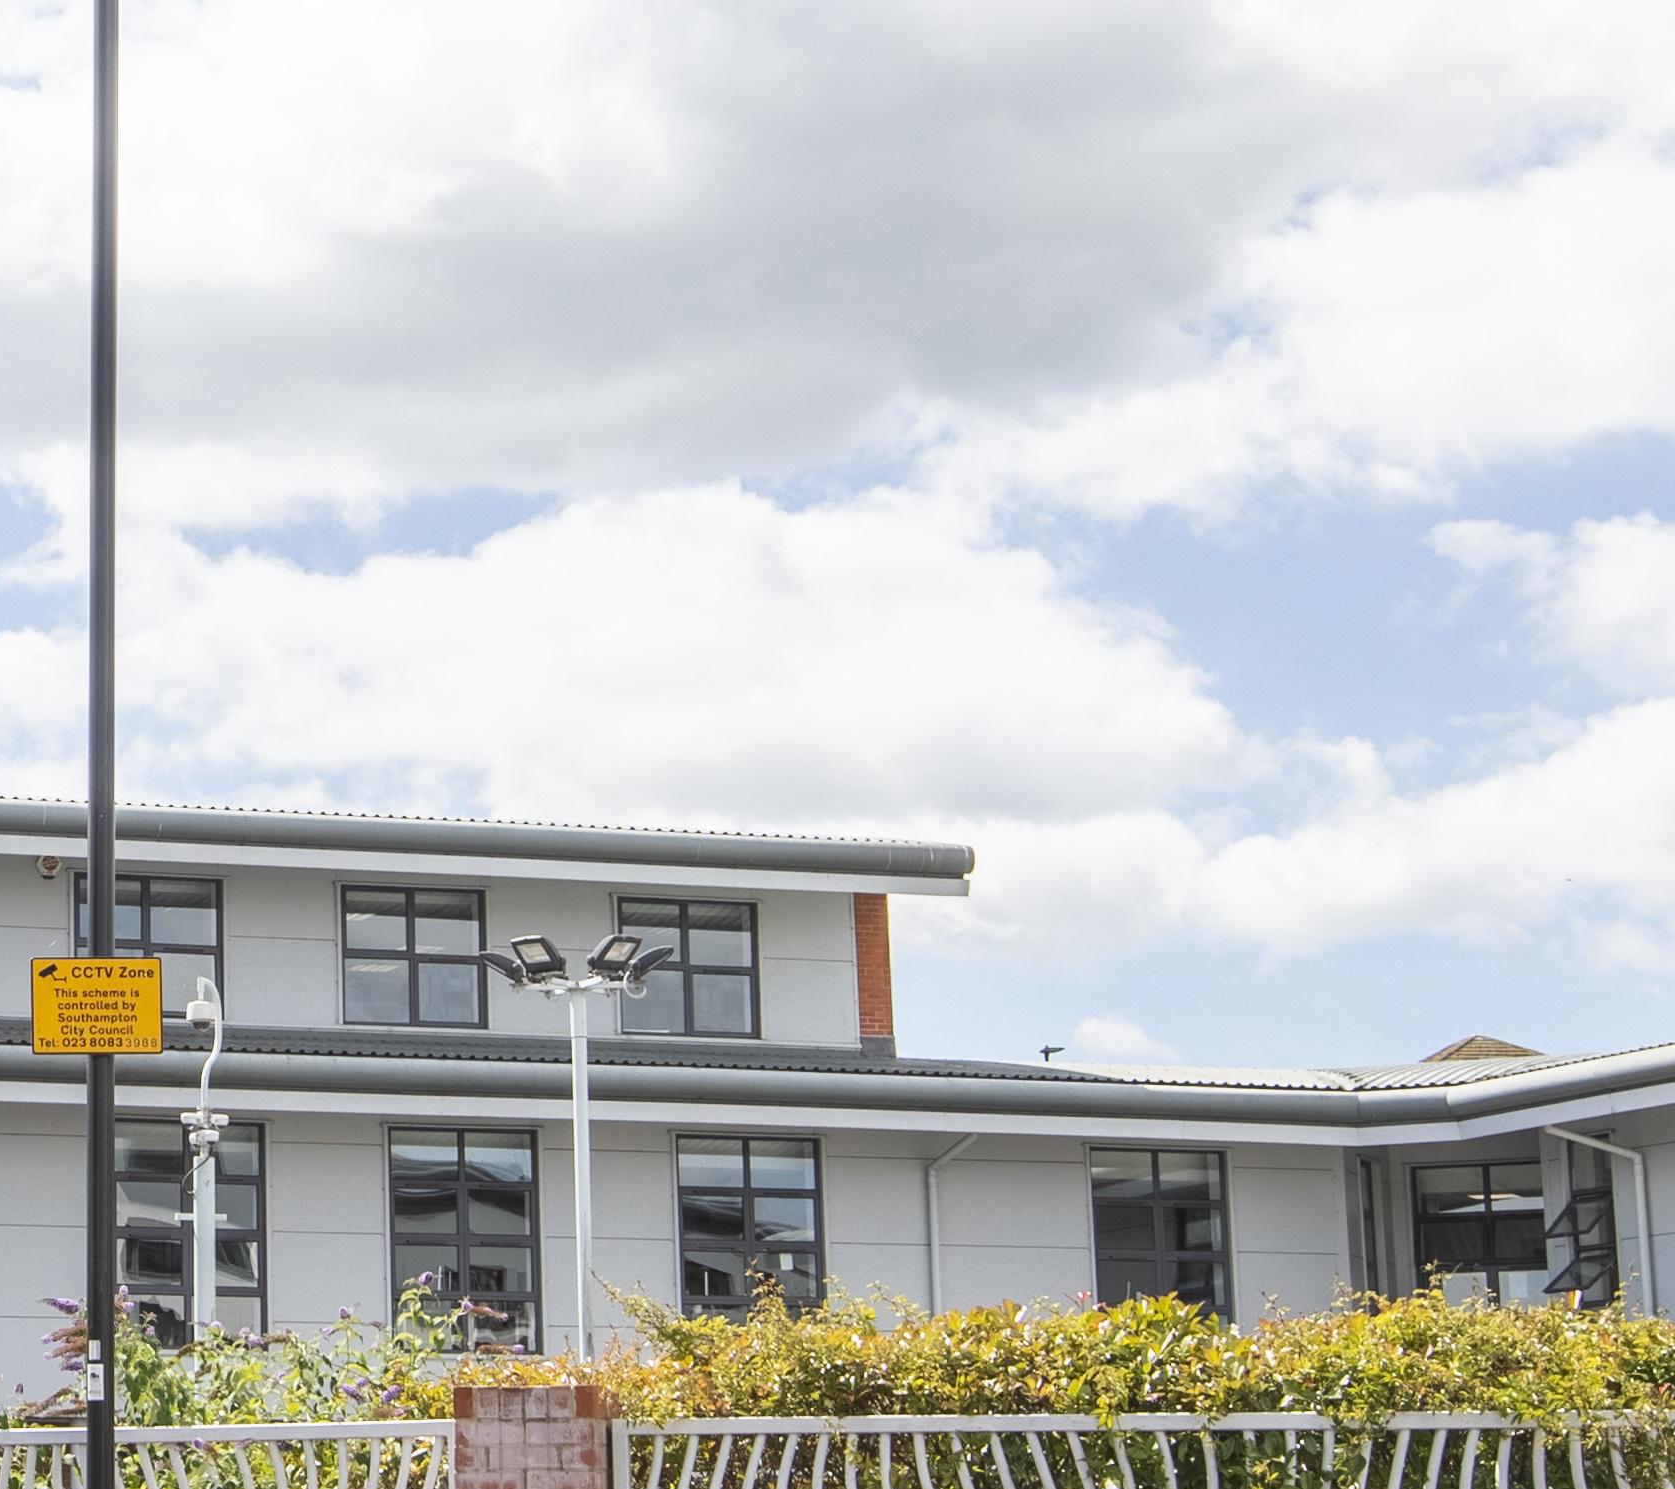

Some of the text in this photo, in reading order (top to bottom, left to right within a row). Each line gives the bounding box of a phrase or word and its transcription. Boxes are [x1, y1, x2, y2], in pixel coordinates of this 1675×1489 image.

[71, 966, 155, 978] CCTV Zone
[53, 988, 140, 998] This scheme is
[57, 1001, 136, 1011] controlled by
[57, 1013, 138, 1023] Southampton
[60, 1025, 134, 1037] City Council
[38, 1038, 158, 1047] Tel: 023 8083 3988
